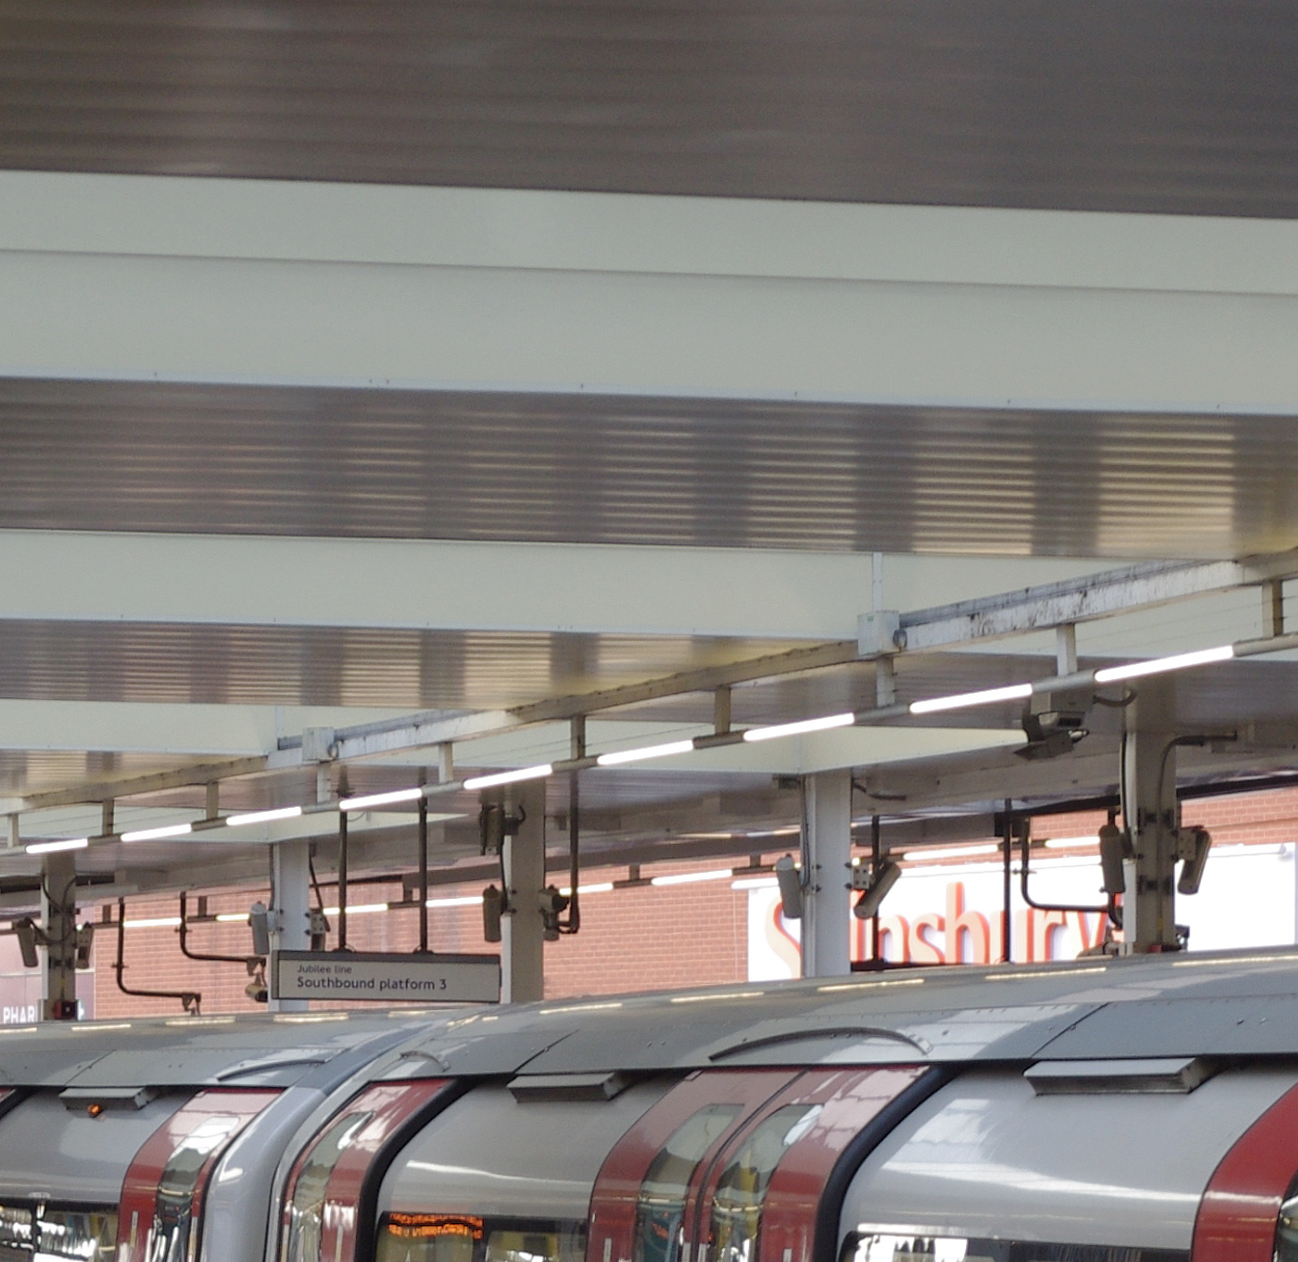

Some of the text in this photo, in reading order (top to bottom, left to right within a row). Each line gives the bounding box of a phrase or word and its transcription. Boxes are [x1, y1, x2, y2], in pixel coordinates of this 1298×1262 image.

[765, 881, 1125, 979] Sinsbury'
[297, 964, 352, 974] Jubilee line
[297, 976, 448, 992] Southbound platform 3
[3, 1005, 38, 1024] PHAR
